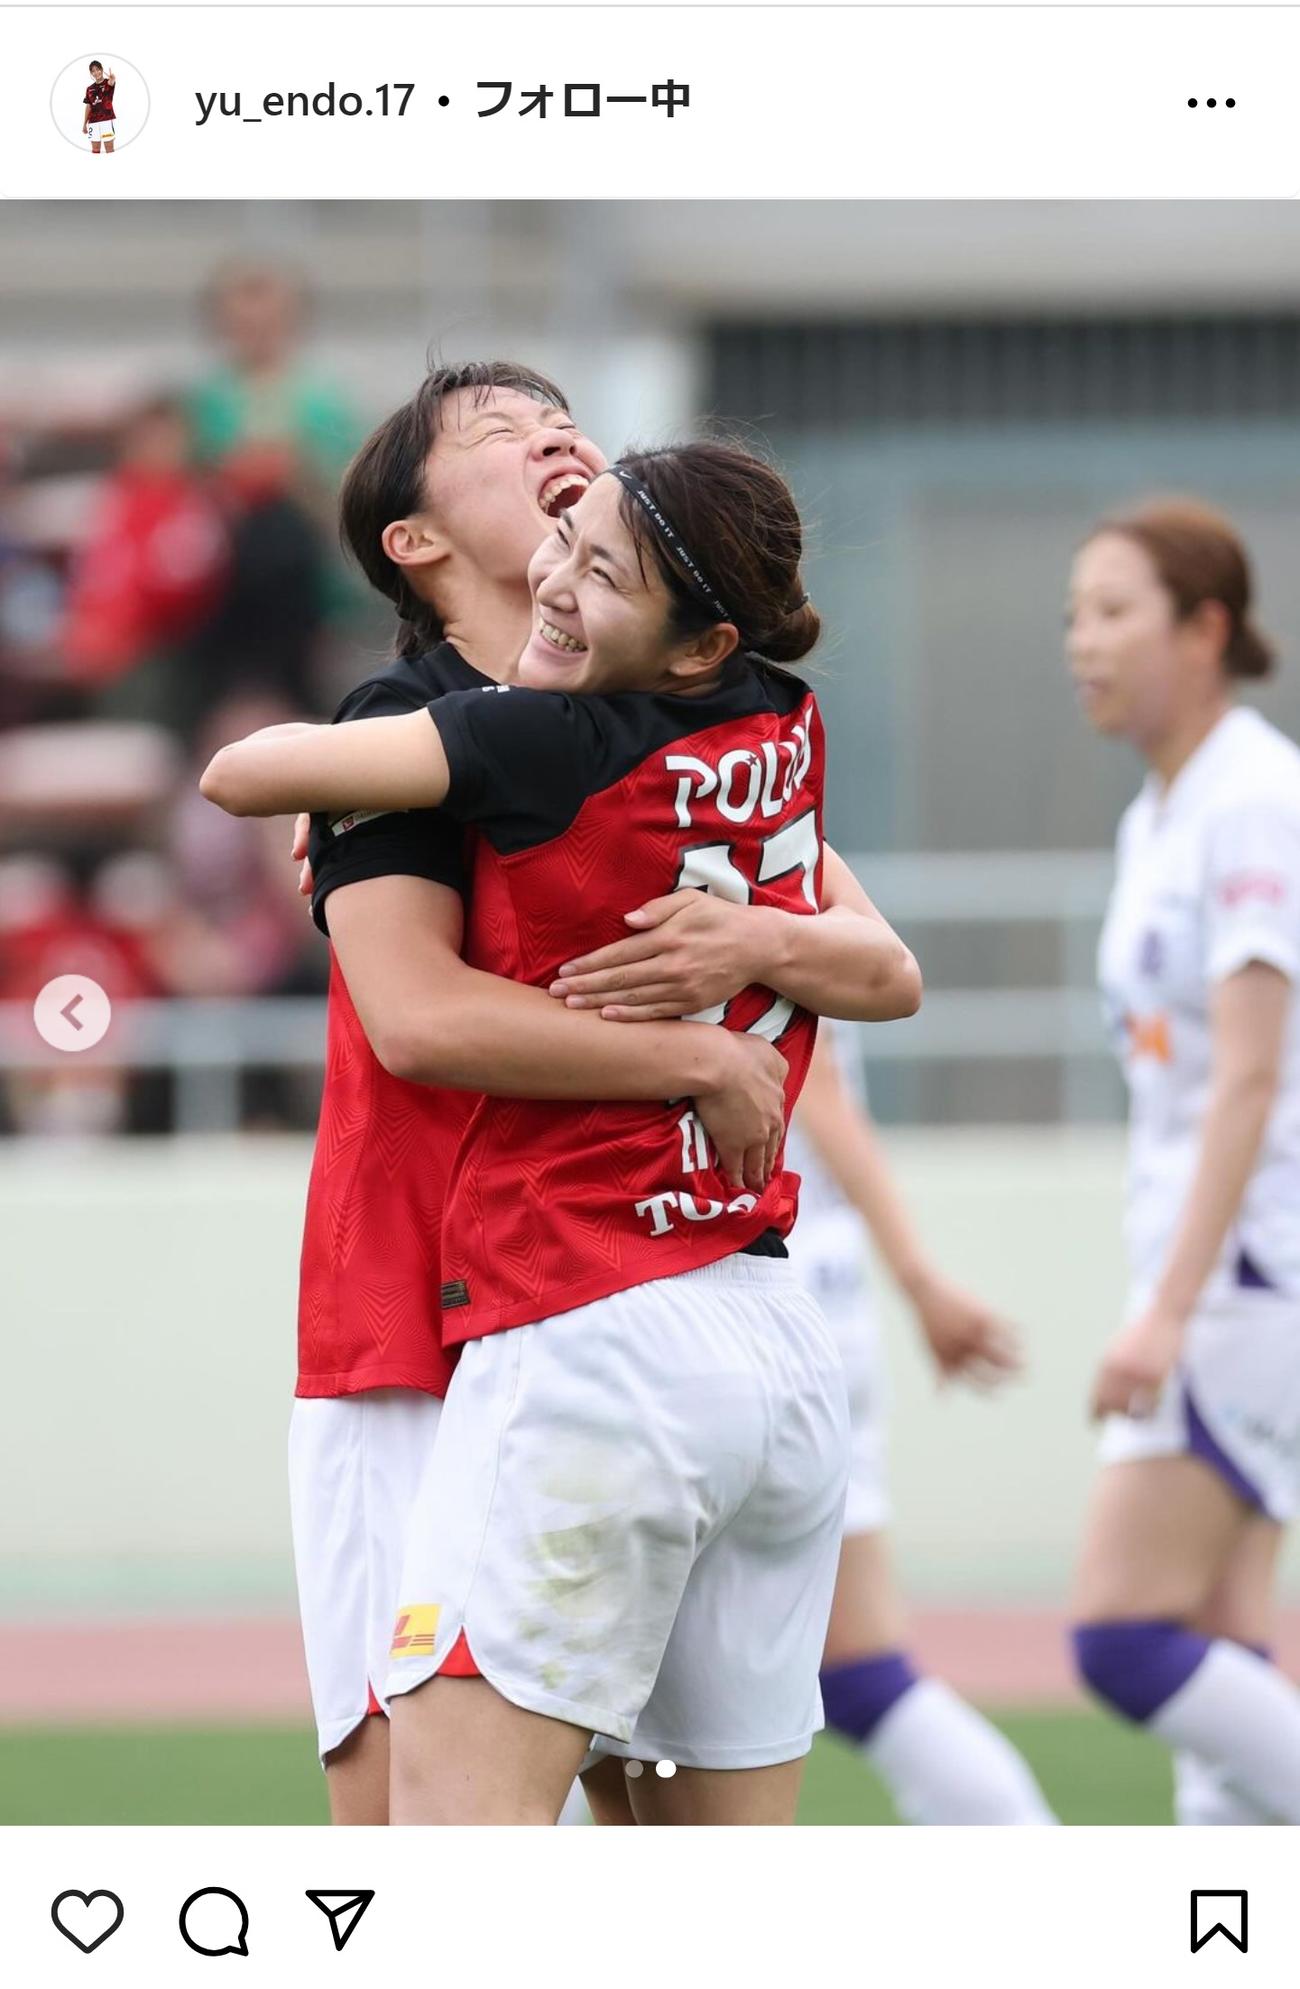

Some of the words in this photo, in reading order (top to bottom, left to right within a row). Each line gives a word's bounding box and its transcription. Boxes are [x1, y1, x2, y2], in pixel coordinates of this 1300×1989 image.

[637, 490, 656, 510] JUST
[654, 512, 665, 526] DO
[664, 527, 675, 538] IT
[676, 546, 695, 568] JUST
[693, 569, 704, 583] DO
[702, 583, 712, 593] IT
